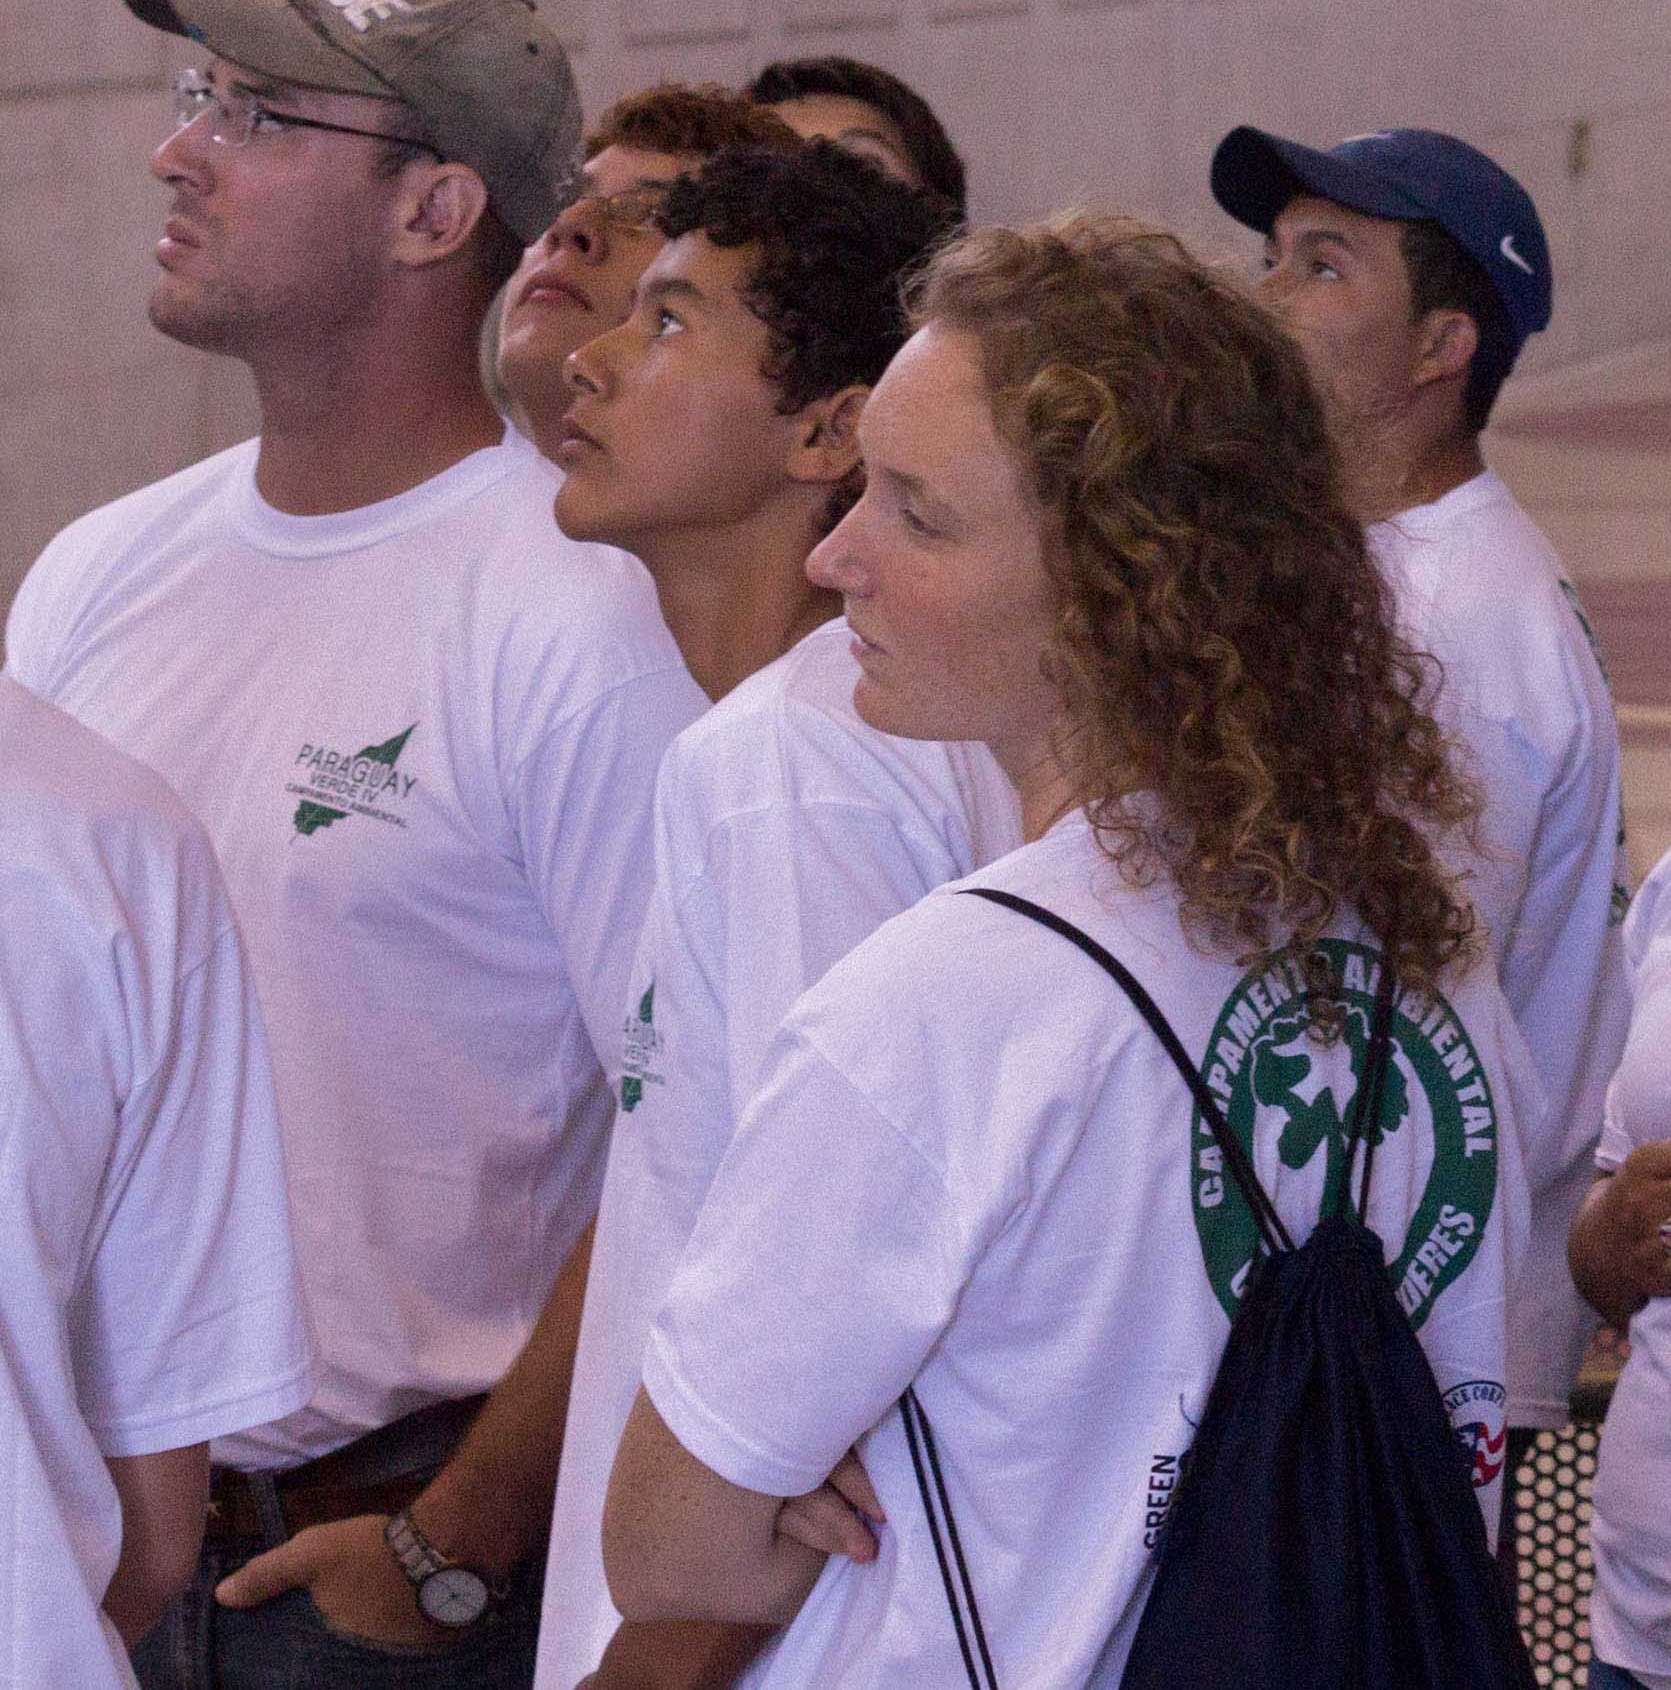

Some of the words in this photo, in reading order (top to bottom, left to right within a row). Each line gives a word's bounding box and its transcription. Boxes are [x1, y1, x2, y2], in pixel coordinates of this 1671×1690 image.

[295, 743, 417, 799] PARAGUAY
[310, 771, 360, 799] VERDE
[361, 789, 379, 803] IV
[1199, 950, 1332, 1208] CAPAMENT
[1394, 1204, 1476, 1317] DERES
[1143, 1454, 1177, 1550] GREEN
